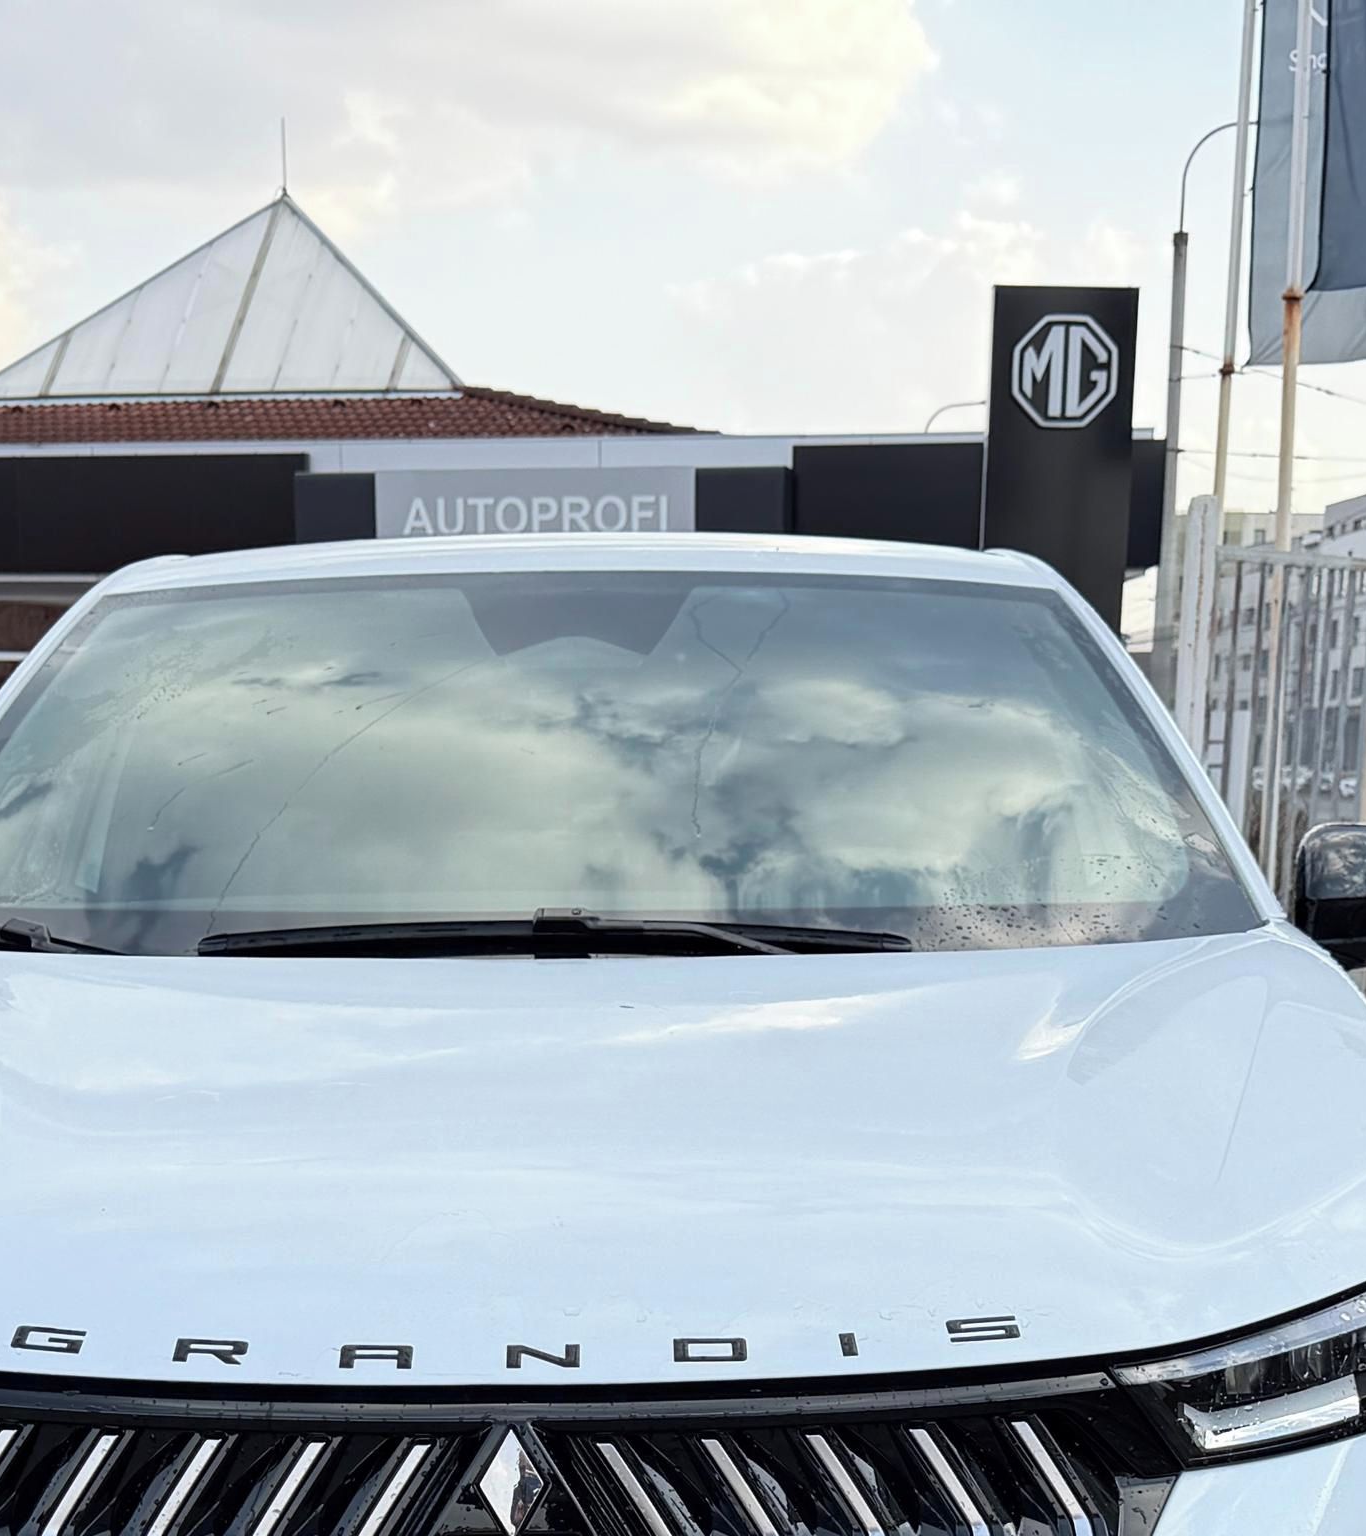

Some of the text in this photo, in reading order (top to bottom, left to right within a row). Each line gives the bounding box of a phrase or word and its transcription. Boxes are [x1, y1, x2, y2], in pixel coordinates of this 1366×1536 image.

[1021, 324, 1109, 418] MG
[402, 494, 668, 535] AUTOPROFI
[10, 1315, 1021, 1370] GRANDIS
